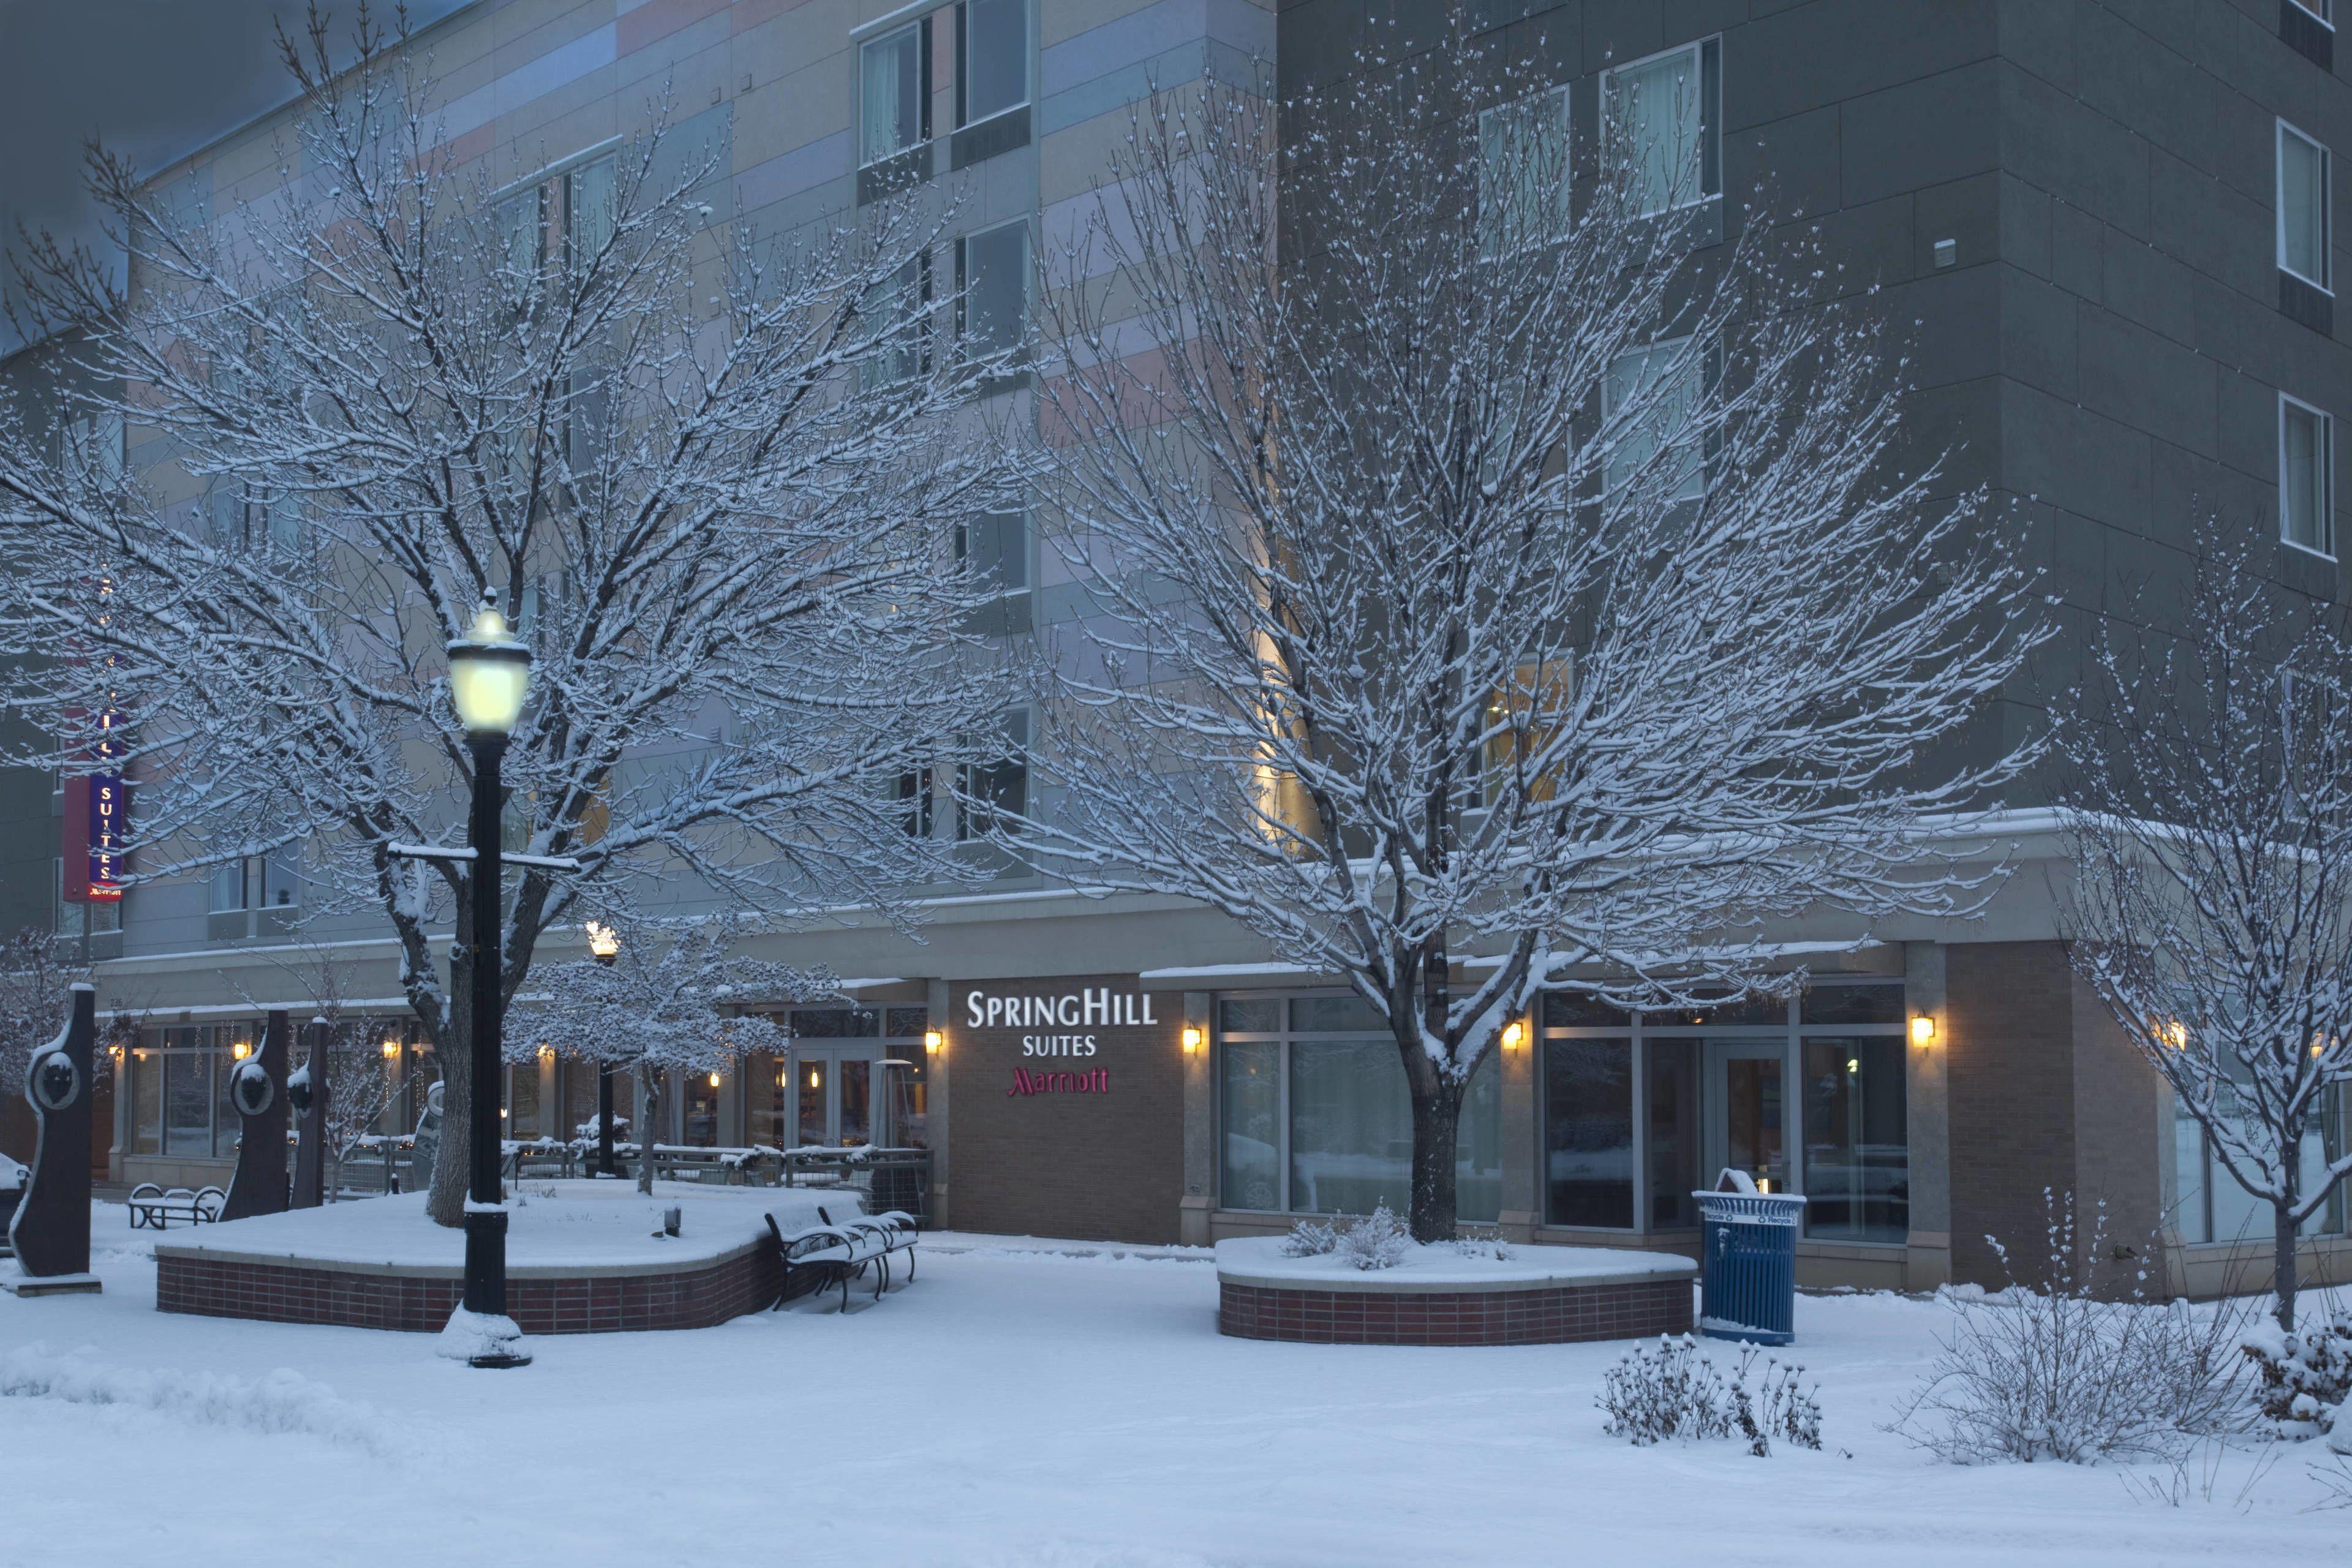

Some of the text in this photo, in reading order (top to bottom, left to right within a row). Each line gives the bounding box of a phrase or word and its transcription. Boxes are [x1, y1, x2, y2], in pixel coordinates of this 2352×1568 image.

[100, 787, 112, 879] SUITES
[967, 987, 1158, 1028] SPRINGHILL
[1022, 1035, 1097, 1057] SUITES
[1007, 1067, 1109, 1096] Marriott
